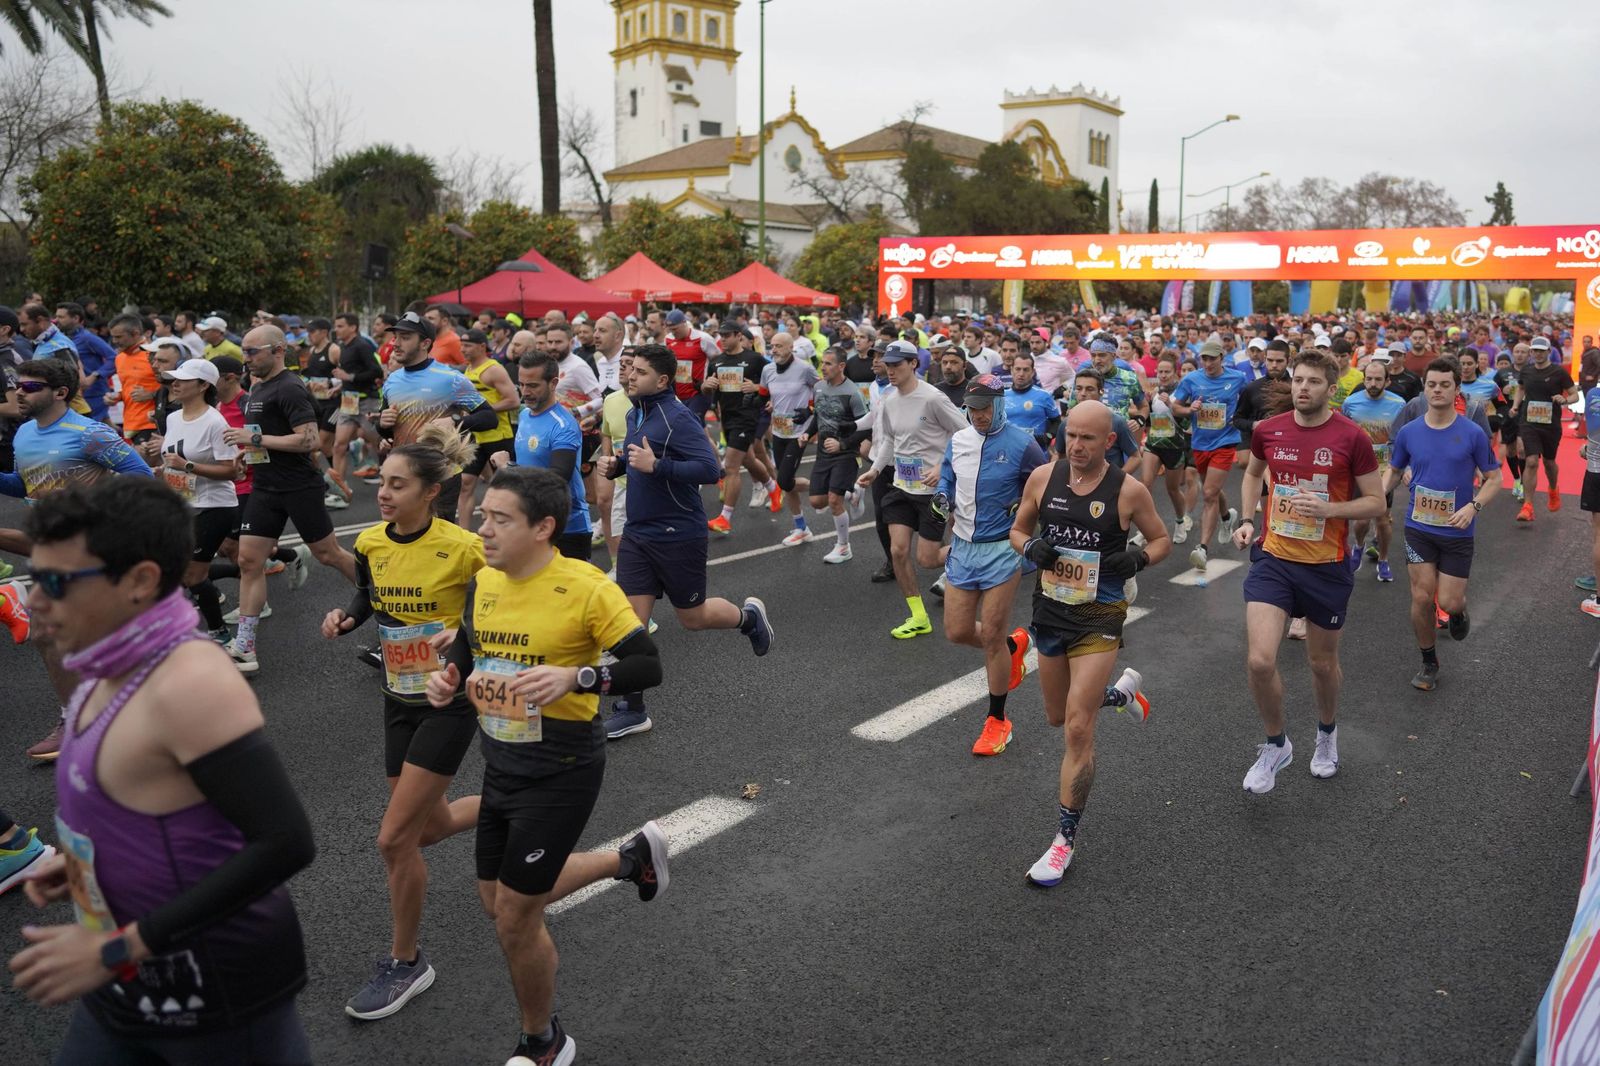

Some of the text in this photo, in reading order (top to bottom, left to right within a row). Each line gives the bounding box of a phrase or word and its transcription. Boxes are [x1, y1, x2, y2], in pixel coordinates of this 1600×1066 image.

[1273, 452, 1298, 461] Londis
[1421, 496, 1447, 511] 8175
[1048, 524, 1101, 543] PLAYAS
[1052, 561, 1083, 581] 990
[374, 586, 423, 597] RUNNING
[474, 630, 530, 646] RUNNING
[387, 640, 431, 665] 6540
